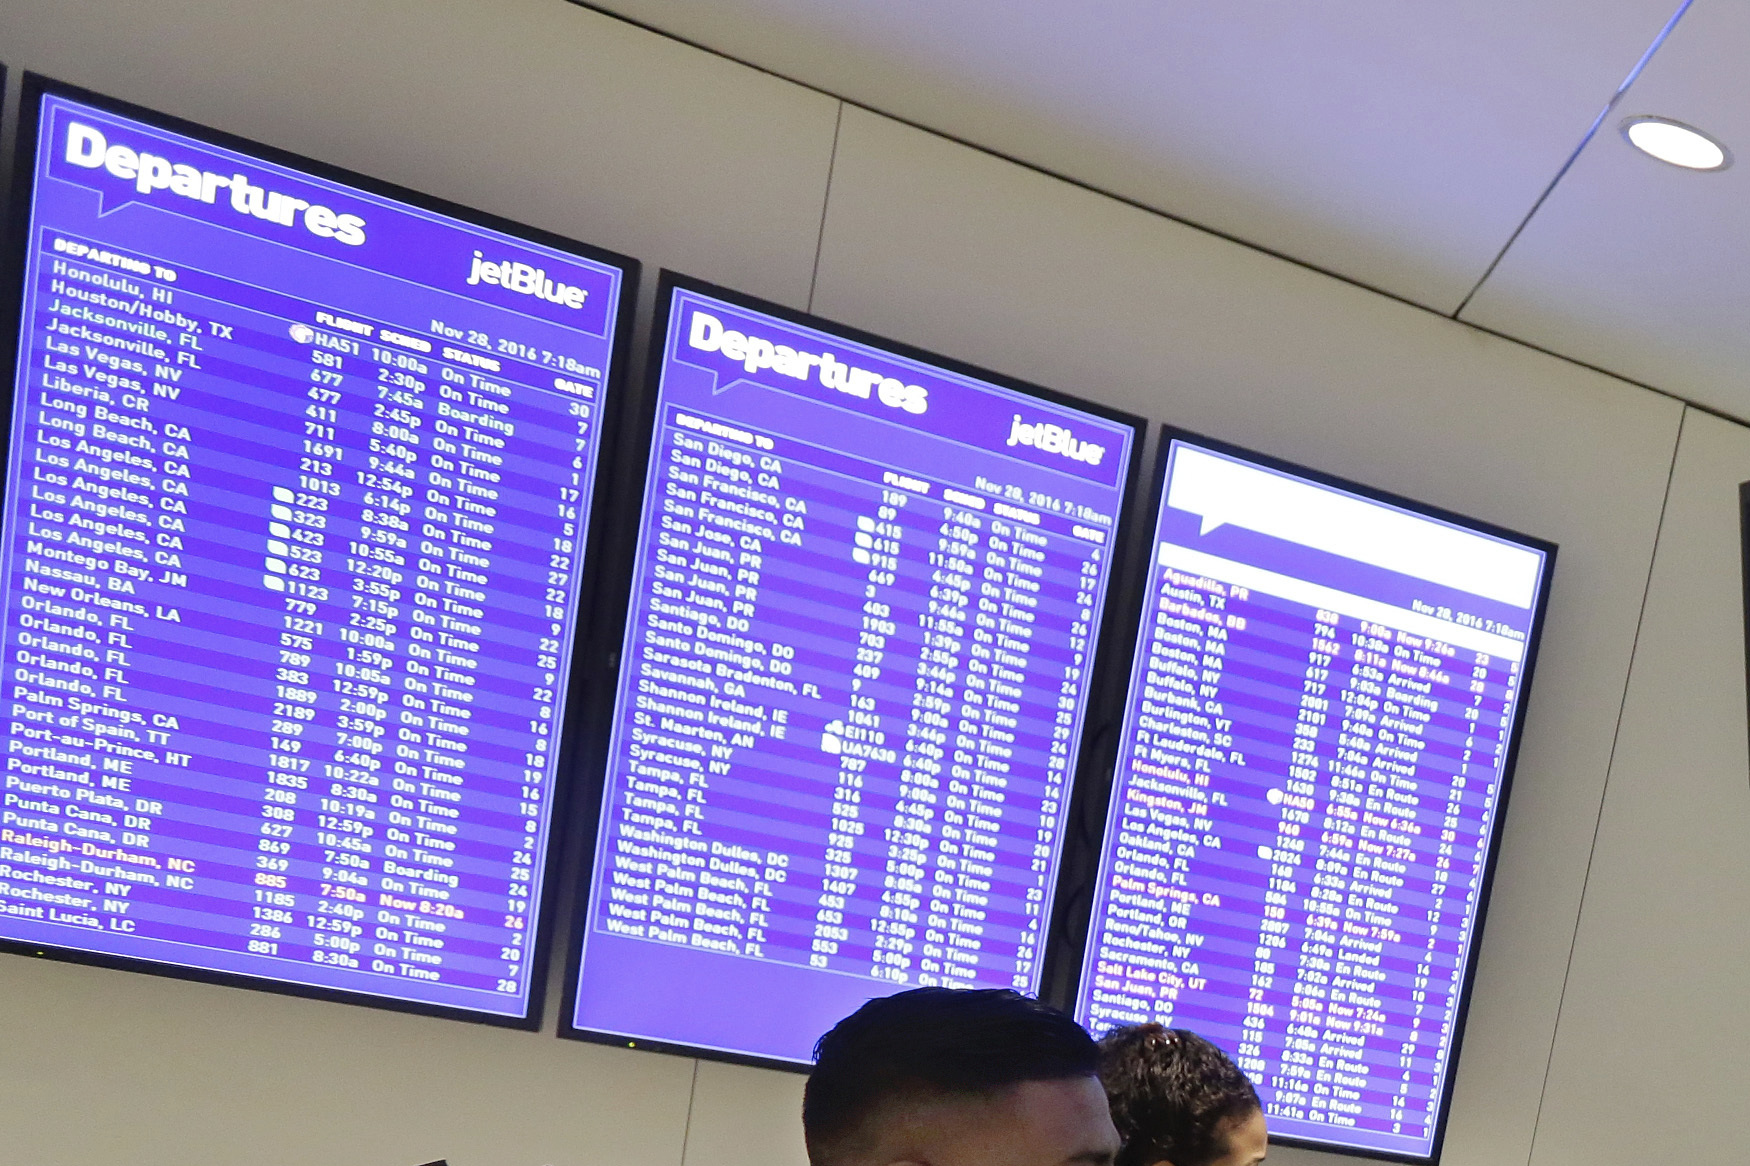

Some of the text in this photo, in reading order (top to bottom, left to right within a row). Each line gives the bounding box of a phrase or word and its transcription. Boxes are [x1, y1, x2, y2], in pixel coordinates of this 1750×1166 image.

[66, 122, 367, 247] Departures
[466, 250, 587, 310] jetBlue
[51, 279, 587, 434] Houston/Hobby, TX 581 2:30p On Time 7
[53, 259, 589, 417] Honolulu, HI HA51 10:00a On Time 30
[430, 319, 602, 379] Nov 28, 2016 7:18am
[442, 347, 500, 371] STATUS
[554, 378, 593, 398] GATE
[689, 310, 929, 415] Departures
[44, 354, 578, 501] Las Vegas, NV 711 5:40p On Time 17
[1006, 414, 1105, 466] jetBlue
[975, 476, 1002, 495] Nov
[1029, 492, 1061, 513] 2016
[27, 540, 556, 668] Montego Bay, JM 779 2:25p On Time 25
[1412, 599, 1435, 617] Nov
[12, 703, 538, 816] Port of Spain, TT 1817 10:22a On Time 15
[16, 650, 544, 767] Orlando, FL 2189 3:59p On Time 18
[10, 721, 536, 832] Port-au-Prince, HT 1835 8:30a On Time 8
[1, 828, 523, 929] Raleigh-Durham, NC 885 7:50a Now 8:20a 26
